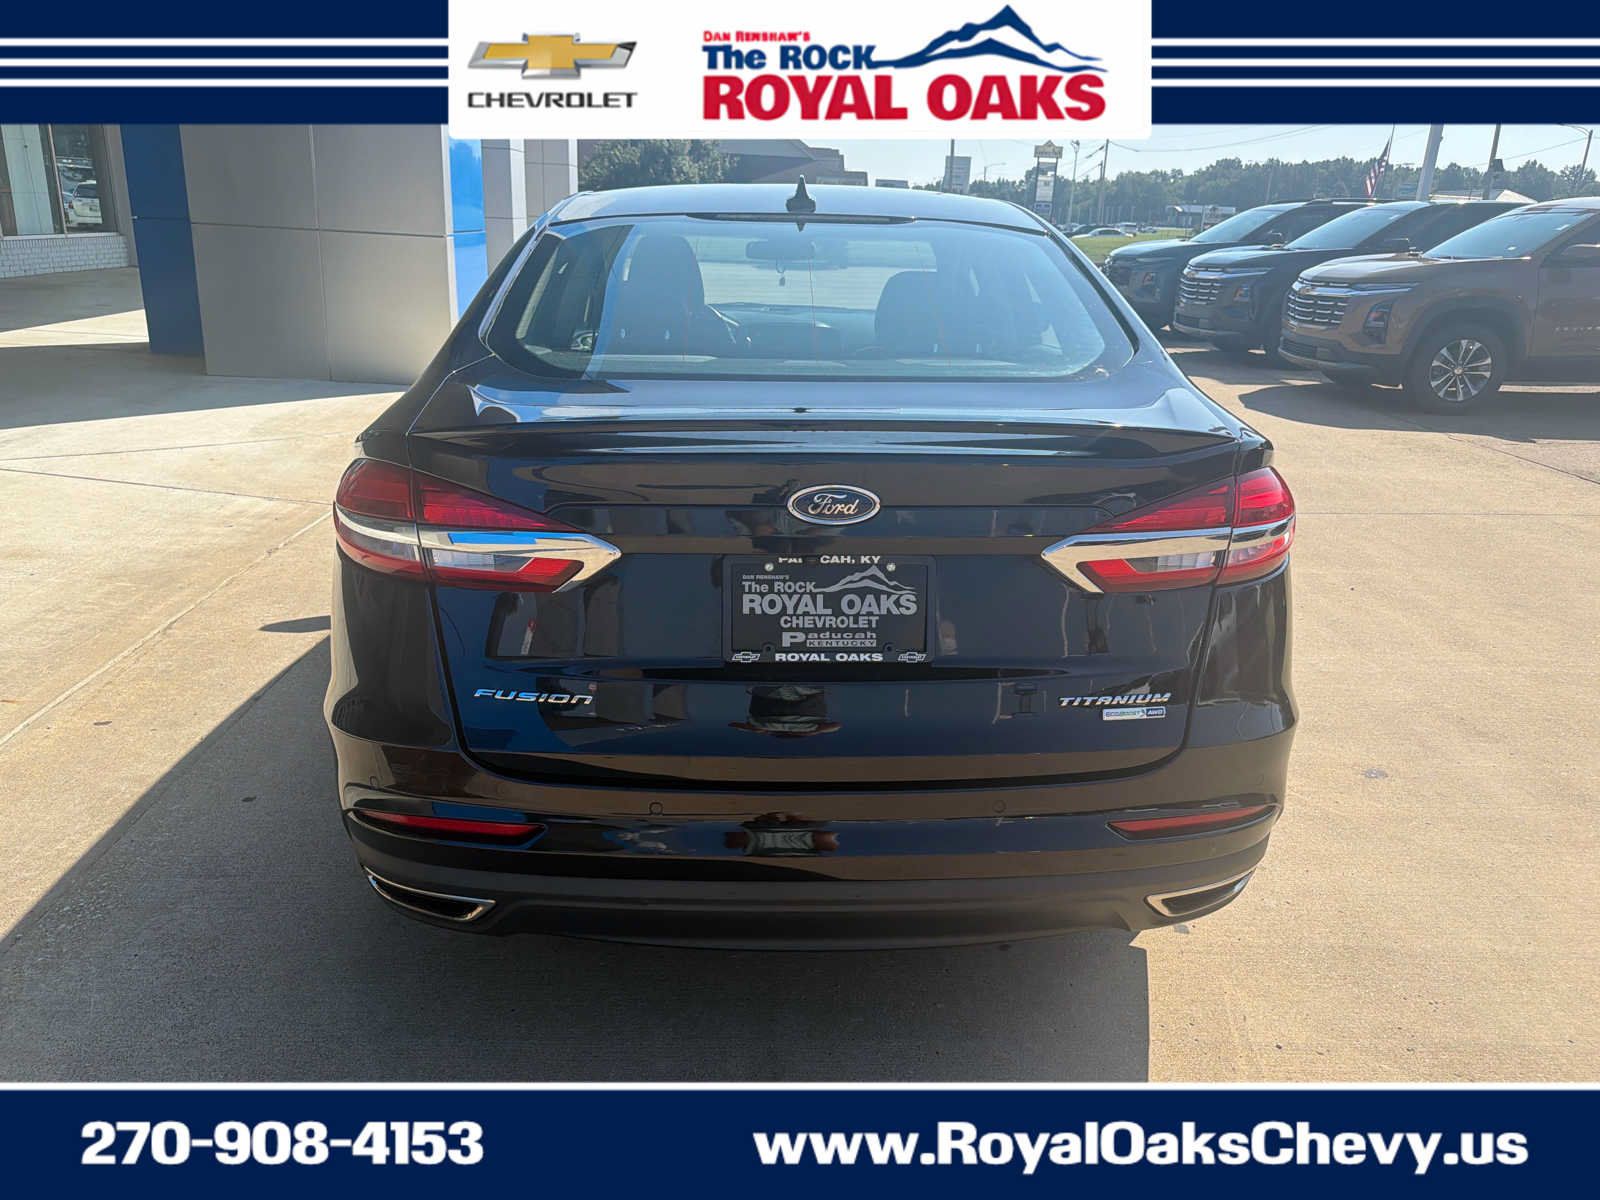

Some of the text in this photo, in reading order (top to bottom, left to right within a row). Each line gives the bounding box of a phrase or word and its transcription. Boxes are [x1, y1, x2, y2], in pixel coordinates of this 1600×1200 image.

[808, 493, 859, 514] Ford
[861, 555, 881, 564] KY
[742, 581, 816, 593] The ROCK
[742, 594, 918, 615] ROYAL OAKS
[780, 616, 879, 628] CHEVROLET
[781, 631, 876, 647] Paducah
[775, 653, 883, 662] ROYAL OAKS
[473, 688, 593, 705] FUSION
[1059, 693, 1171, 707] TITANIUM
